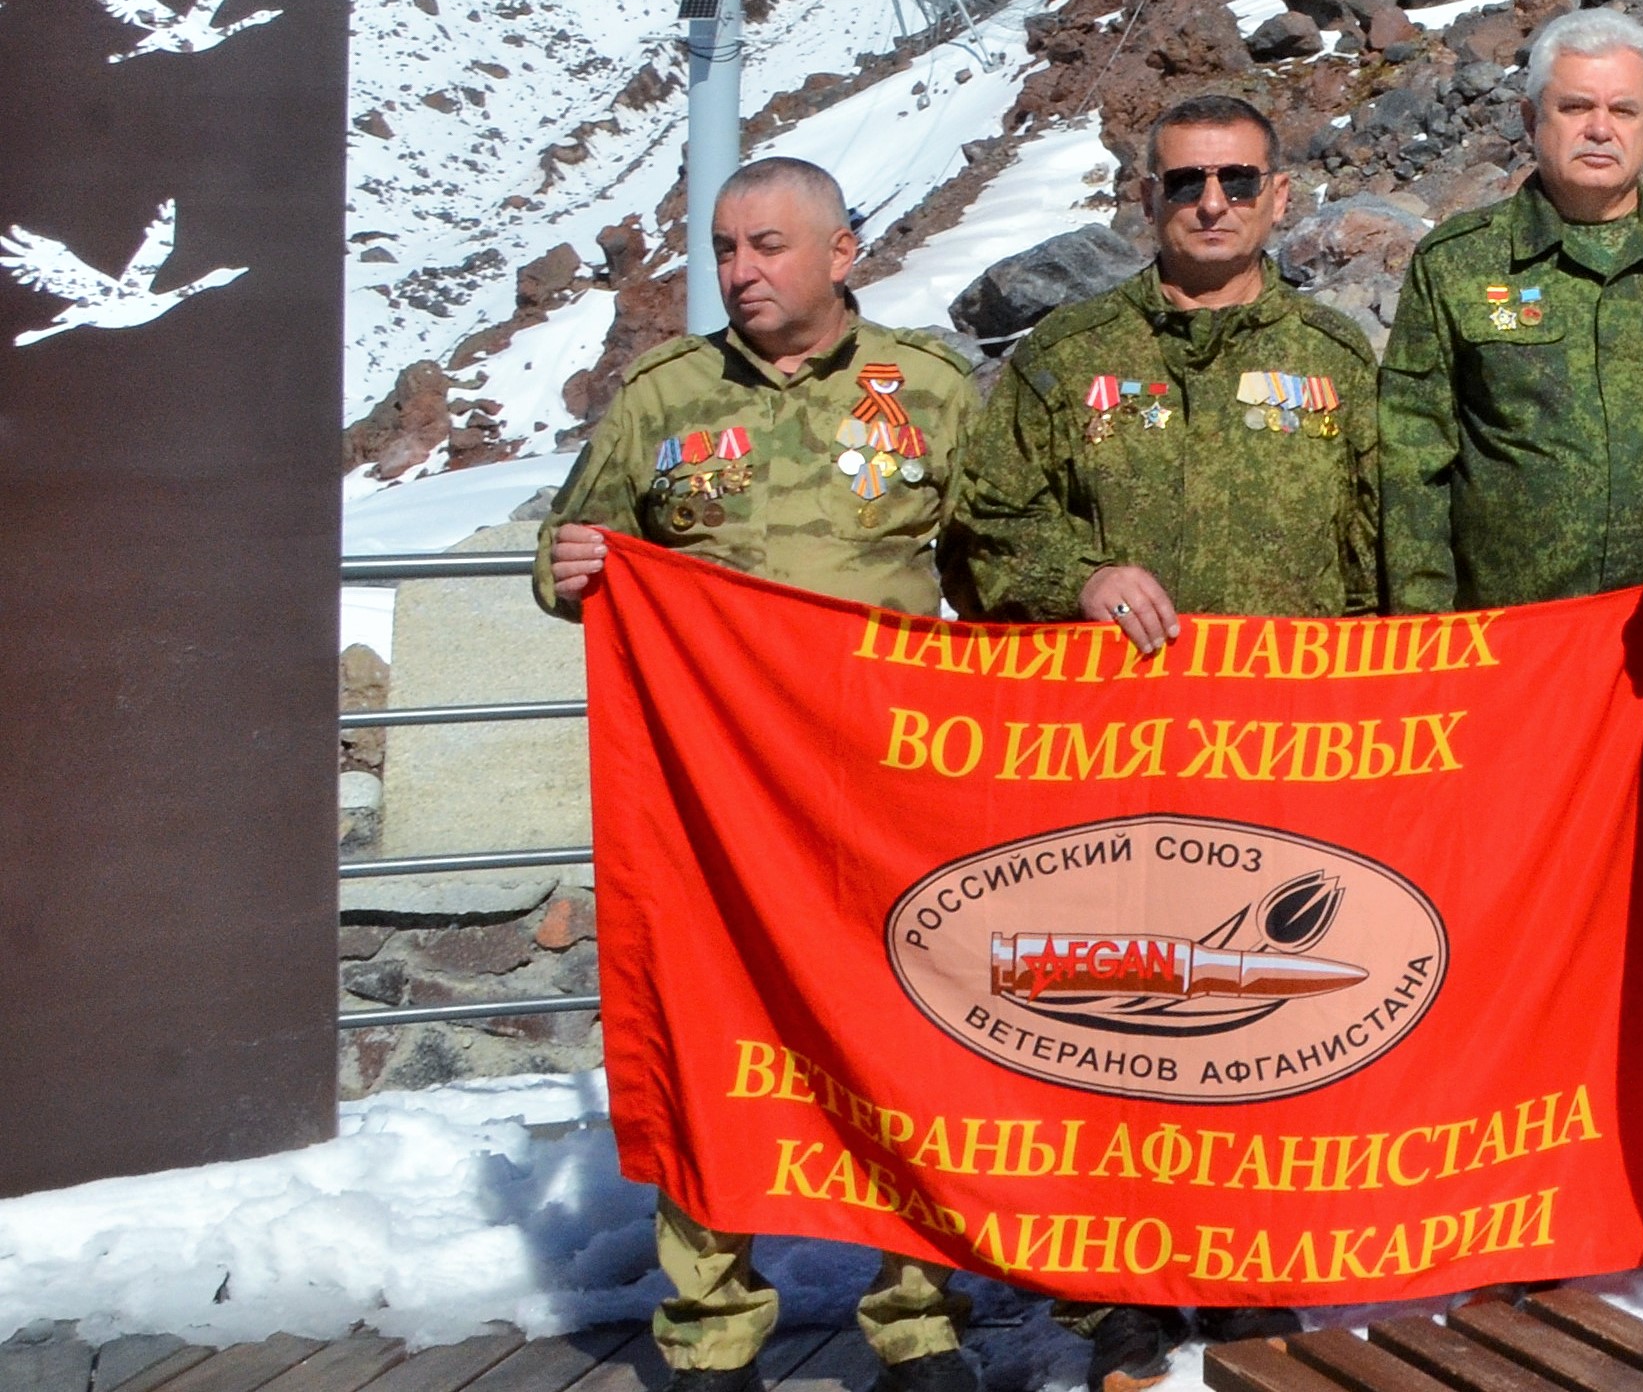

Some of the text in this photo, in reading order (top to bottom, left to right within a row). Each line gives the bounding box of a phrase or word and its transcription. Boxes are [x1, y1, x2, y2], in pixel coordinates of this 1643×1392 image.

[853, 609, 1505, 682] ПАМЯТИ ПАВШИХ
[881, 707, 1467, 783] ВО ИМЯ ЖИВЫХ
[906, 832, 1263, 951] РОССИЙСКИЙ СОЮЗ
[1020, 933, 1177, 1002] AFGAN
[964, 952, 1434, 1085] ВЕТЕРАНОВ АФГАНИСТАНА
[726, 1039, 1602, 1192] ВЕТЕРАНЫ АФГАНИСТАНА
